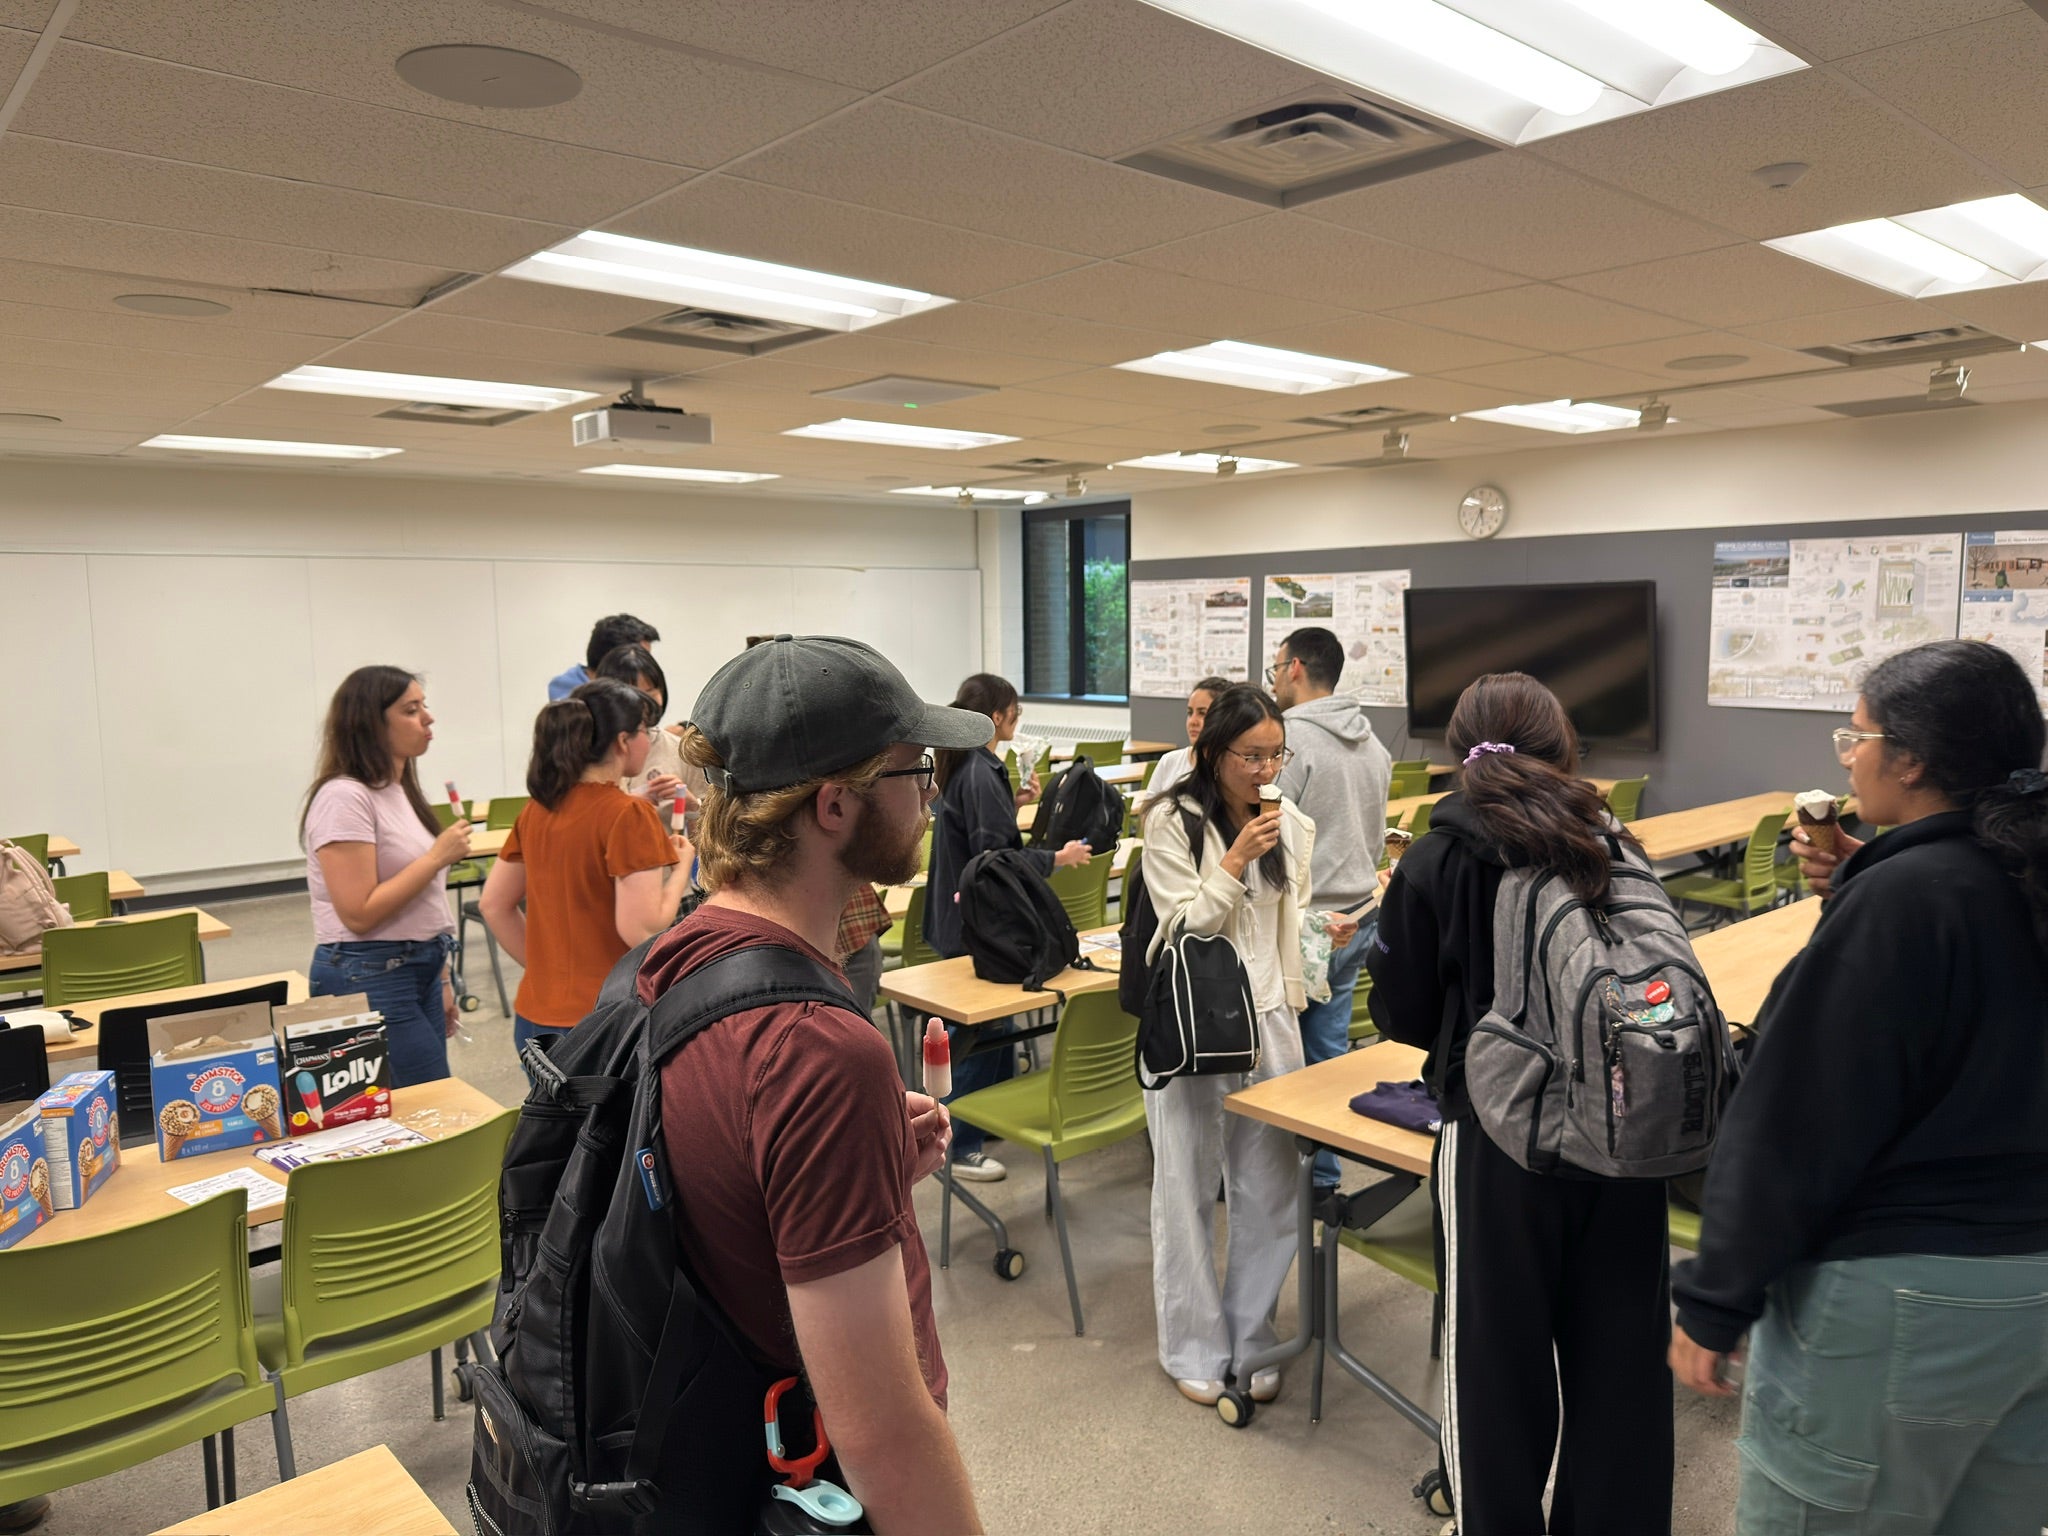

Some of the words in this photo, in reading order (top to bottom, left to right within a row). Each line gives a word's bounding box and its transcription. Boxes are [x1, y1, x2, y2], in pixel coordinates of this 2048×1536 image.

[190, 1067, 246, 1093] DRUMSTICK
[322, 1056, 383, 1097] Lolly
[212, 1080, 226, 1096] 8
[374, 1104, 389, 1114] 28
[97, 1112, 102, 1128] 8
[10, 1160, 19, 1179] 8
